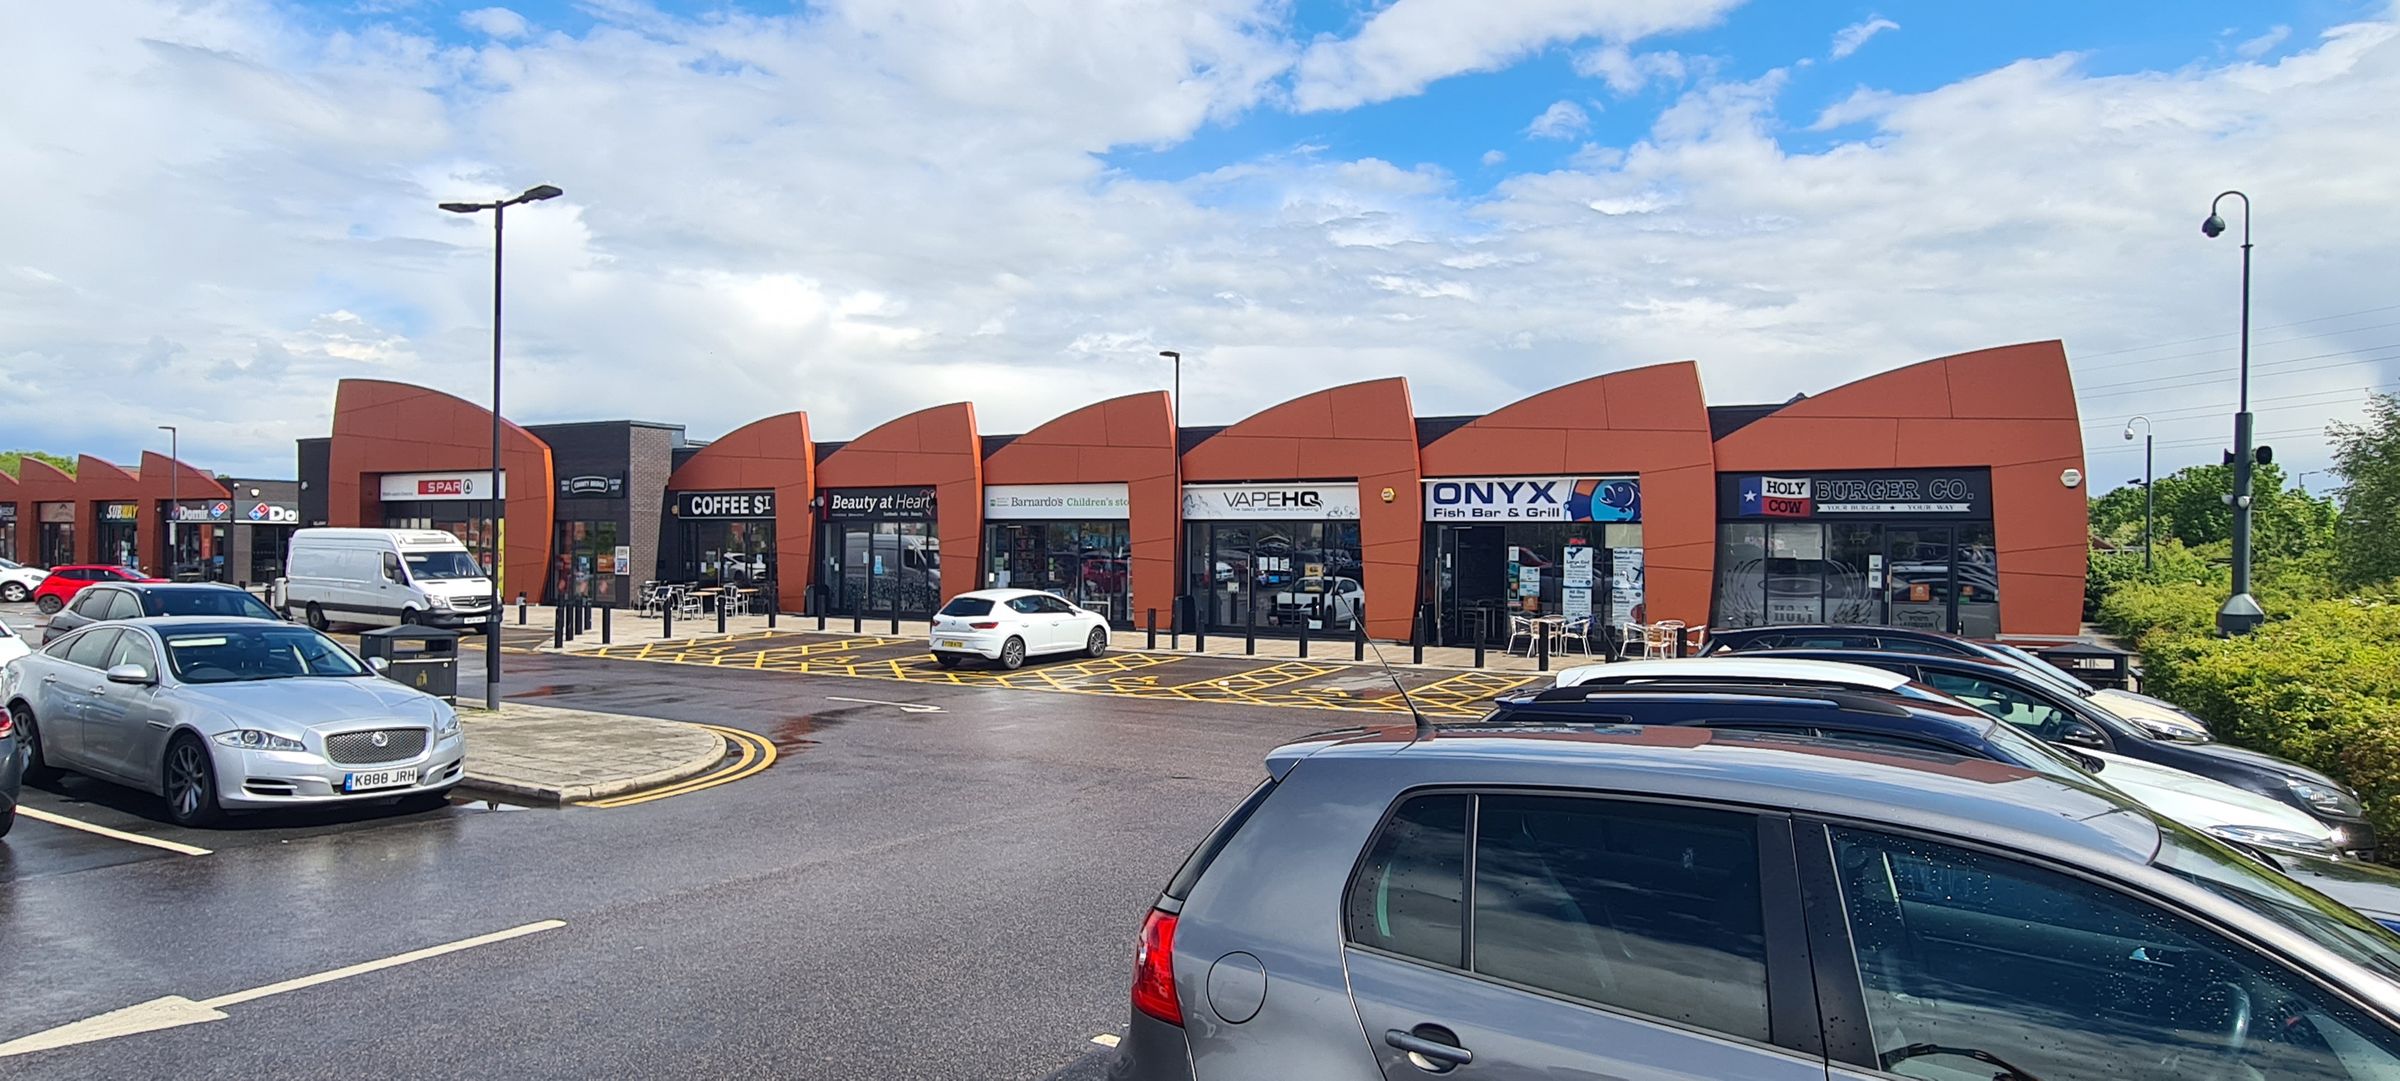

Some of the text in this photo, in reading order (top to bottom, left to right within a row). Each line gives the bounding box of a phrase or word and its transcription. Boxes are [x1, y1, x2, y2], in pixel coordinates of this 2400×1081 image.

[427, 481, 461, 493] SPAR
[1433, 481, 1558, 505] ONYX
[1766, 480, 1806, 496] HOLY
[1815, 478, 1974, 501] BURGER CO.
[691, 496, 750, 515] COFFEE
[831, 494, 930, 513] Beauty at Heart
[1011, 496, 1064, 507] Barnardo's
[1066, 497, 1114, 507] Children's
[1223, 491, 1324, 509] VAPEHQ
[1768, 499, 1802, 514] COW
[106, 504, 139, 520] SUBWAY
[1433, 507, 1560, 518] Fish Bar & Grill
[354, 768, 416, 788] K888 JRH
